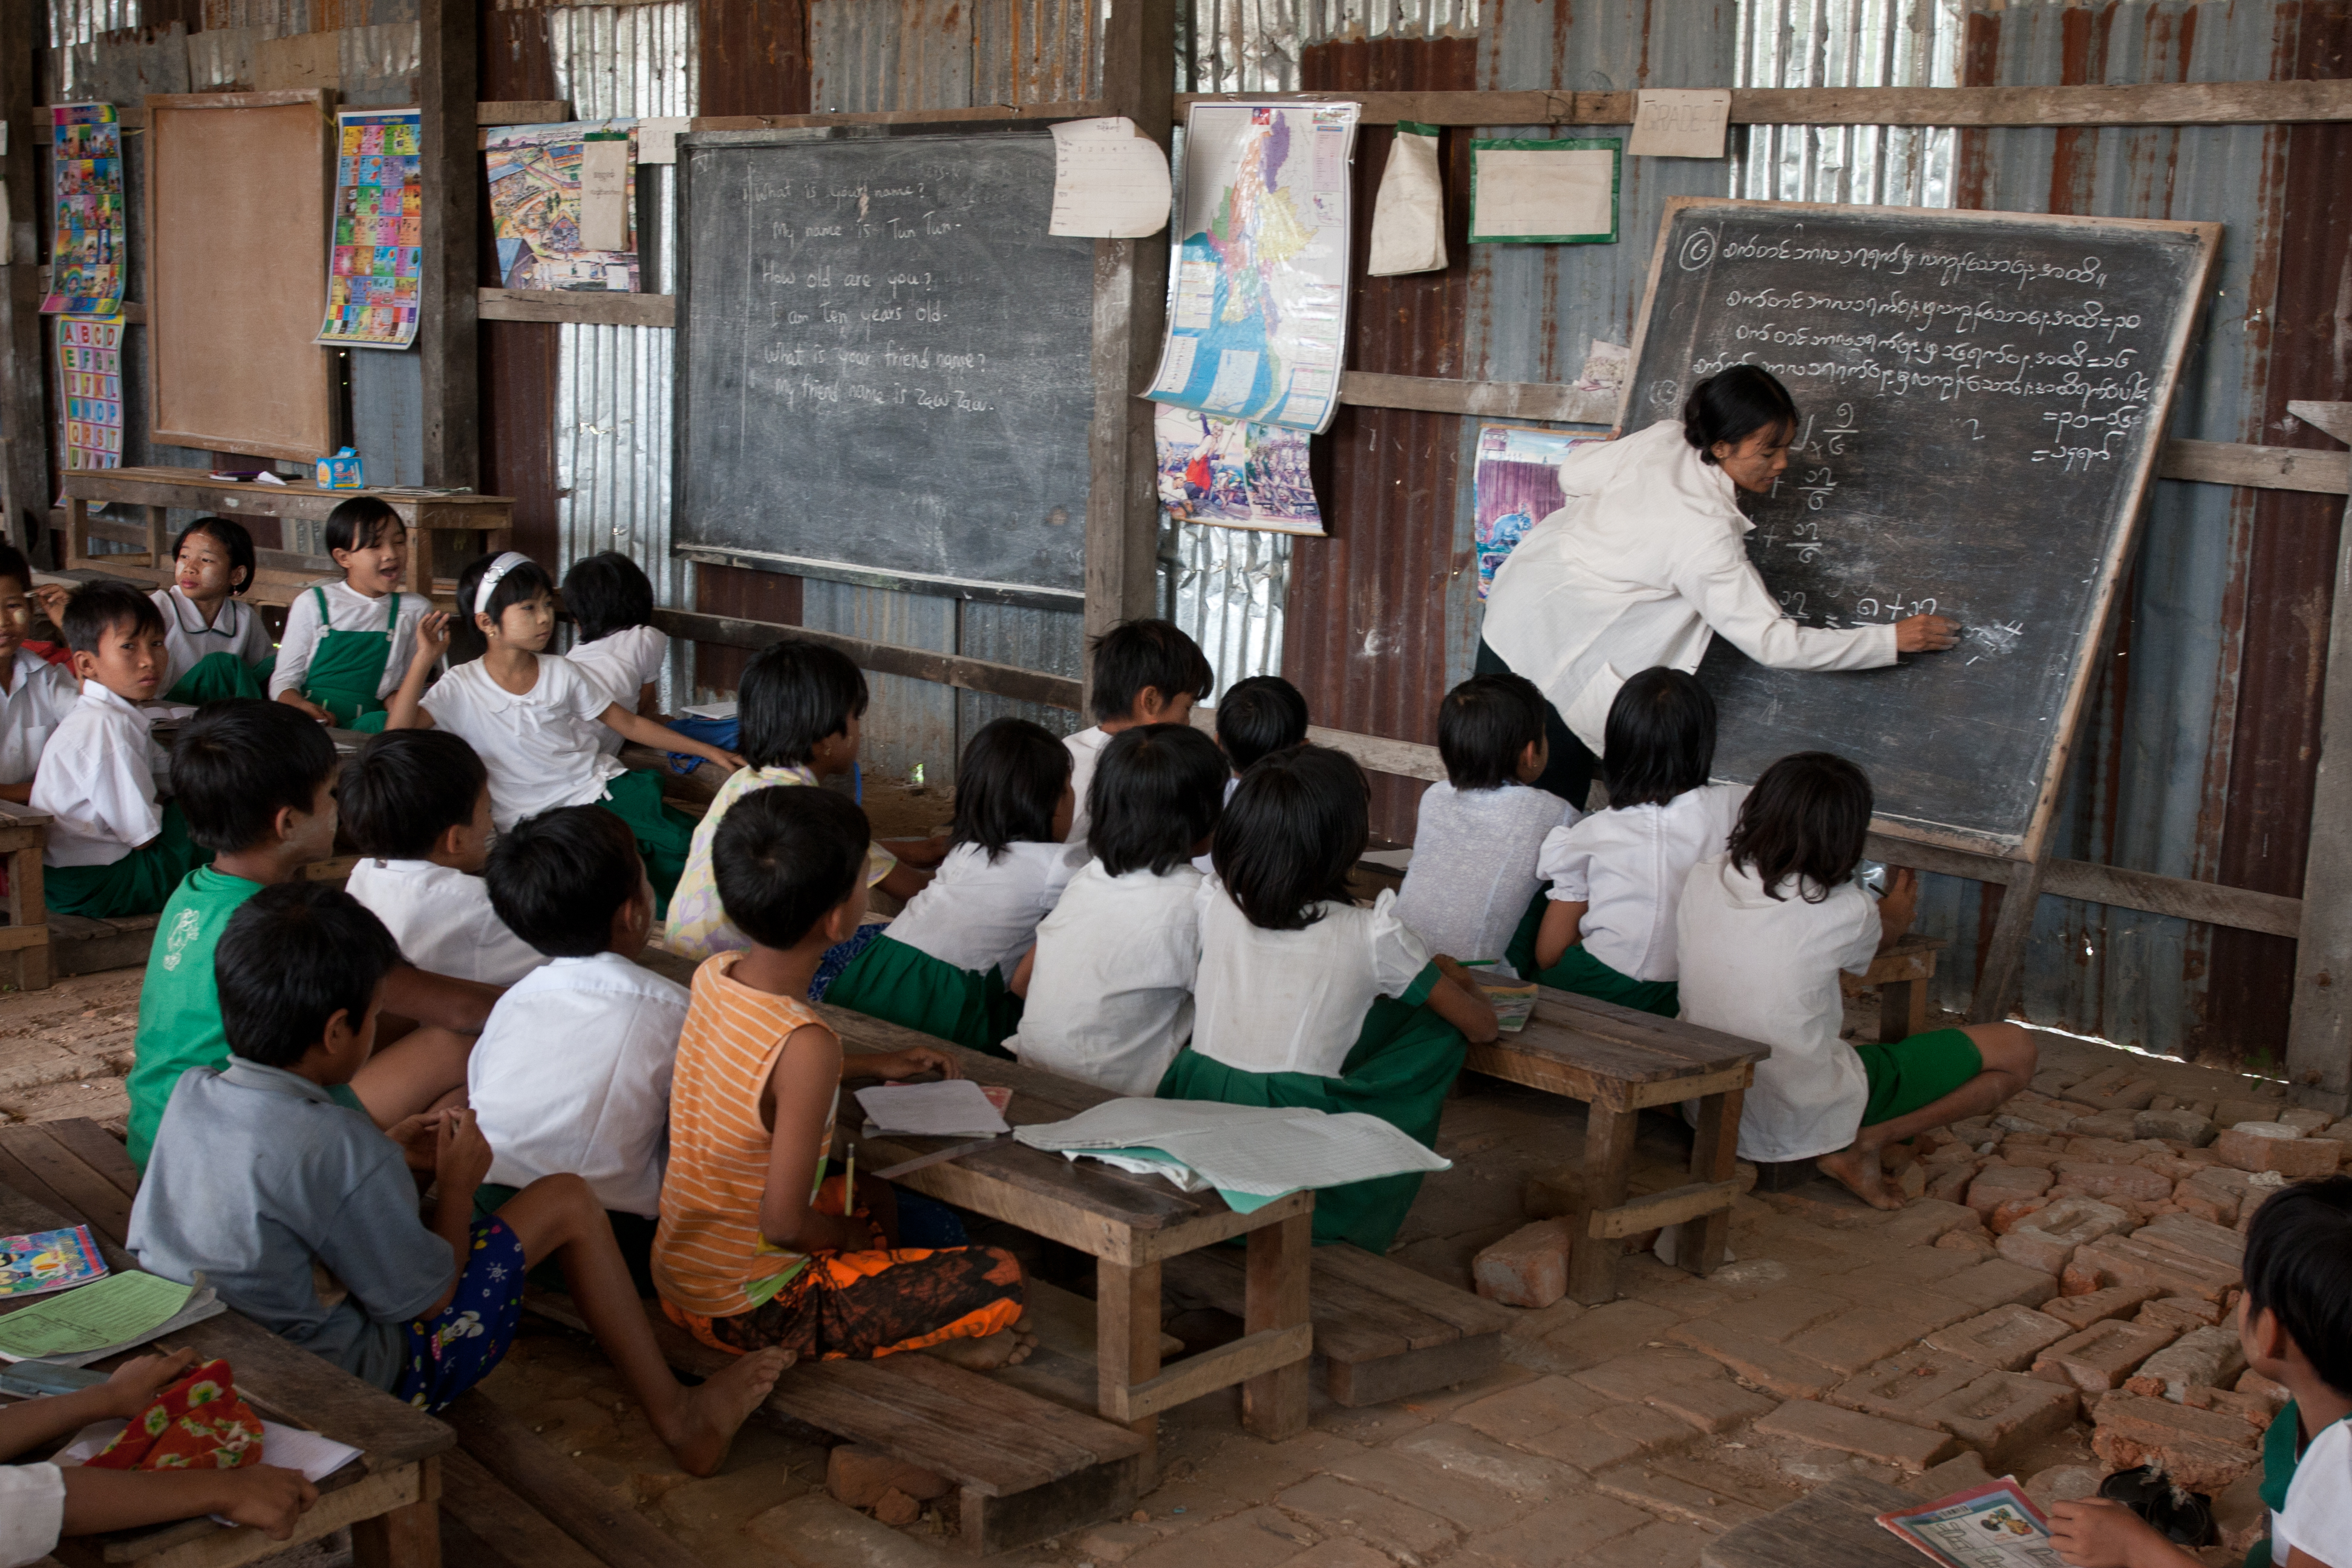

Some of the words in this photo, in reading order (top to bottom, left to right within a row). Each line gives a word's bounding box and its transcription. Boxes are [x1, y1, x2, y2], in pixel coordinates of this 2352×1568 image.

[755, 181, 791, 203] What
[805, 183, 817, 200] is
[805, 224, 843, 238] name
[887, 216, 917, 241] Tun
[762, 258, 796, 286] How
[806, 264, 832, 289] old
[843, 273, 872, 289] are
[787, 310, 809, 325] am
[860, 306, 903, 341] years
[65, 325, 73, 342] A
[82, 325, 90, 344] B
[96, 327, 101, 345] C
[107, 328, 115, 345] D
[66, 350, 76, 367] E
[83, 351, 90, 368] F
[109, 379, 117, 397] L
[97, 403, 104, 421] O
[109, 405, 116, 422] P
[97, 428, 103, 446] S
[110, 431, 117, 449] T
